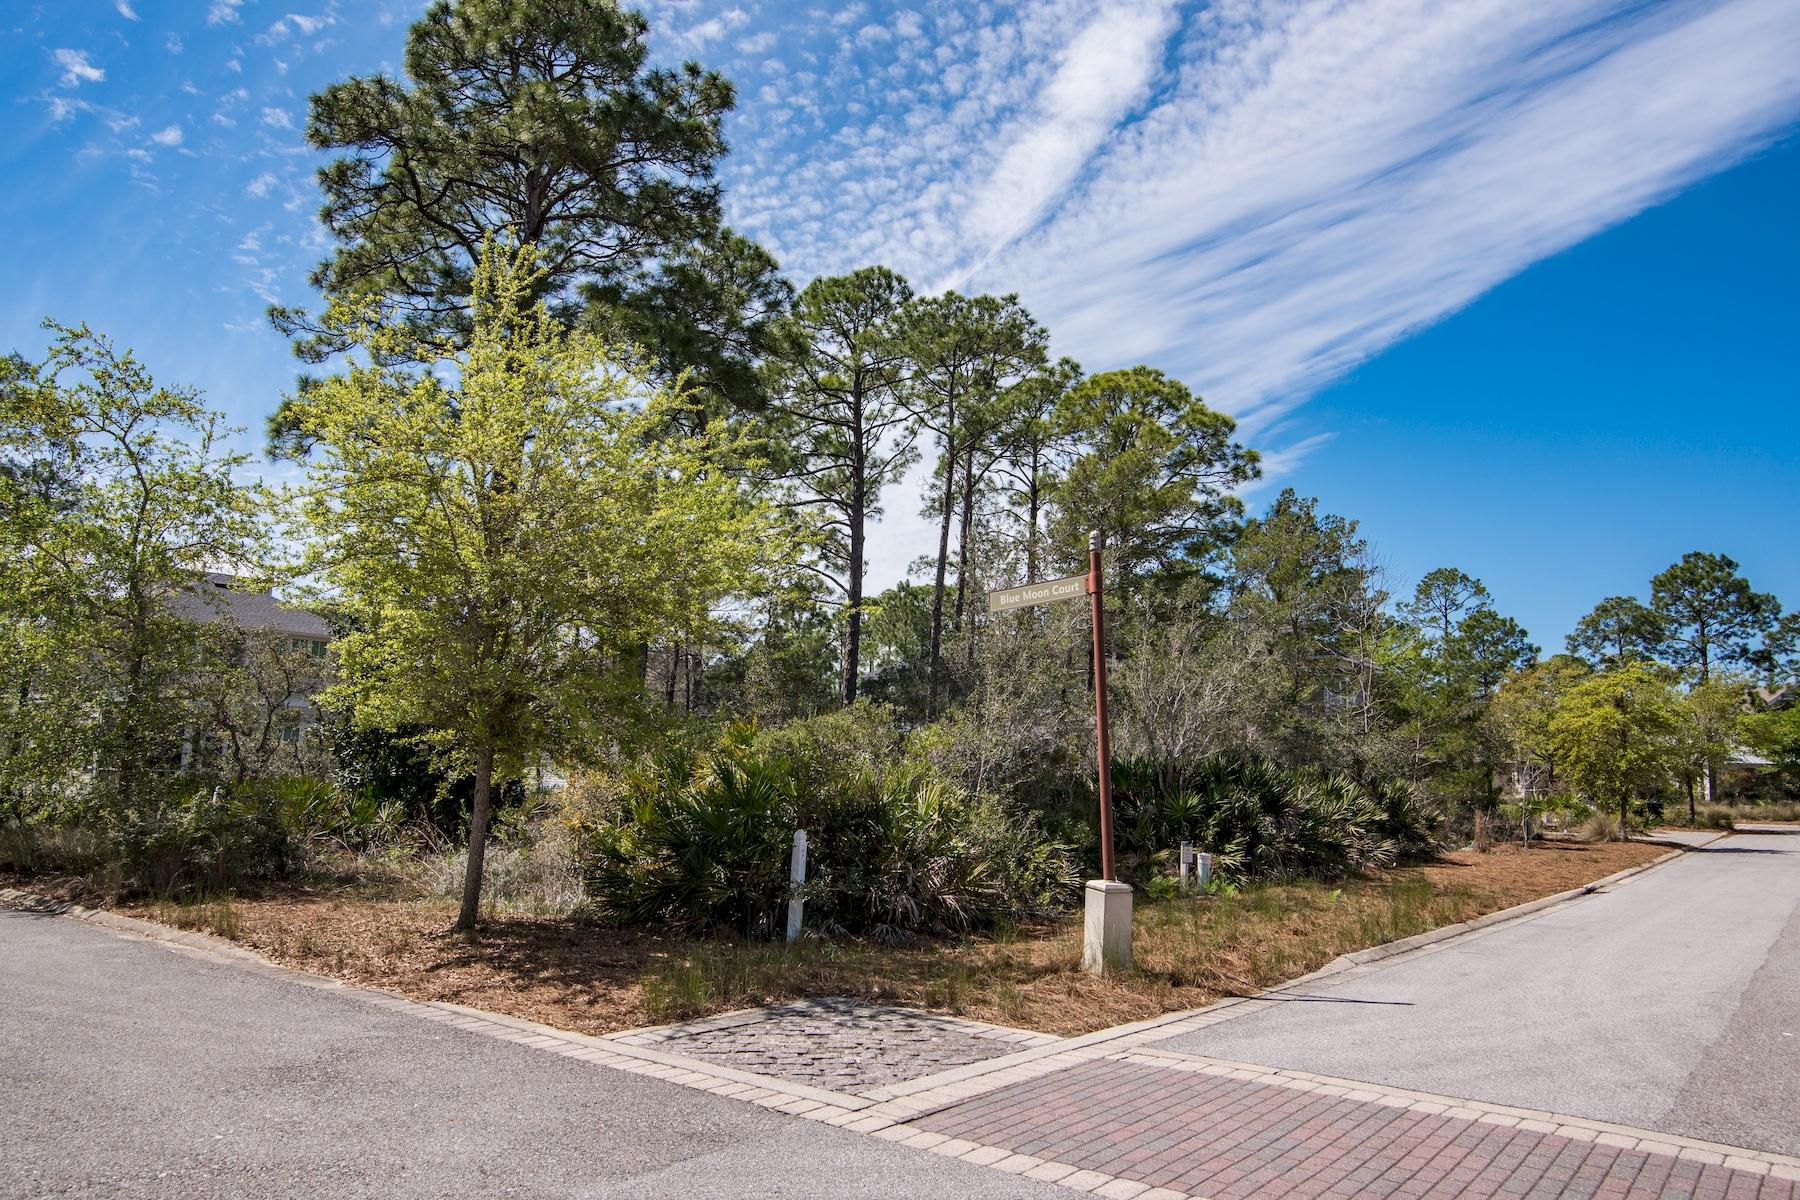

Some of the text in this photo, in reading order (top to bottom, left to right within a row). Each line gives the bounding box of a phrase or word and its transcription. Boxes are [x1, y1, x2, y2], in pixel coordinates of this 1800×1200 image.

[1000, 582, 1079, 604] Blue Moon Court
